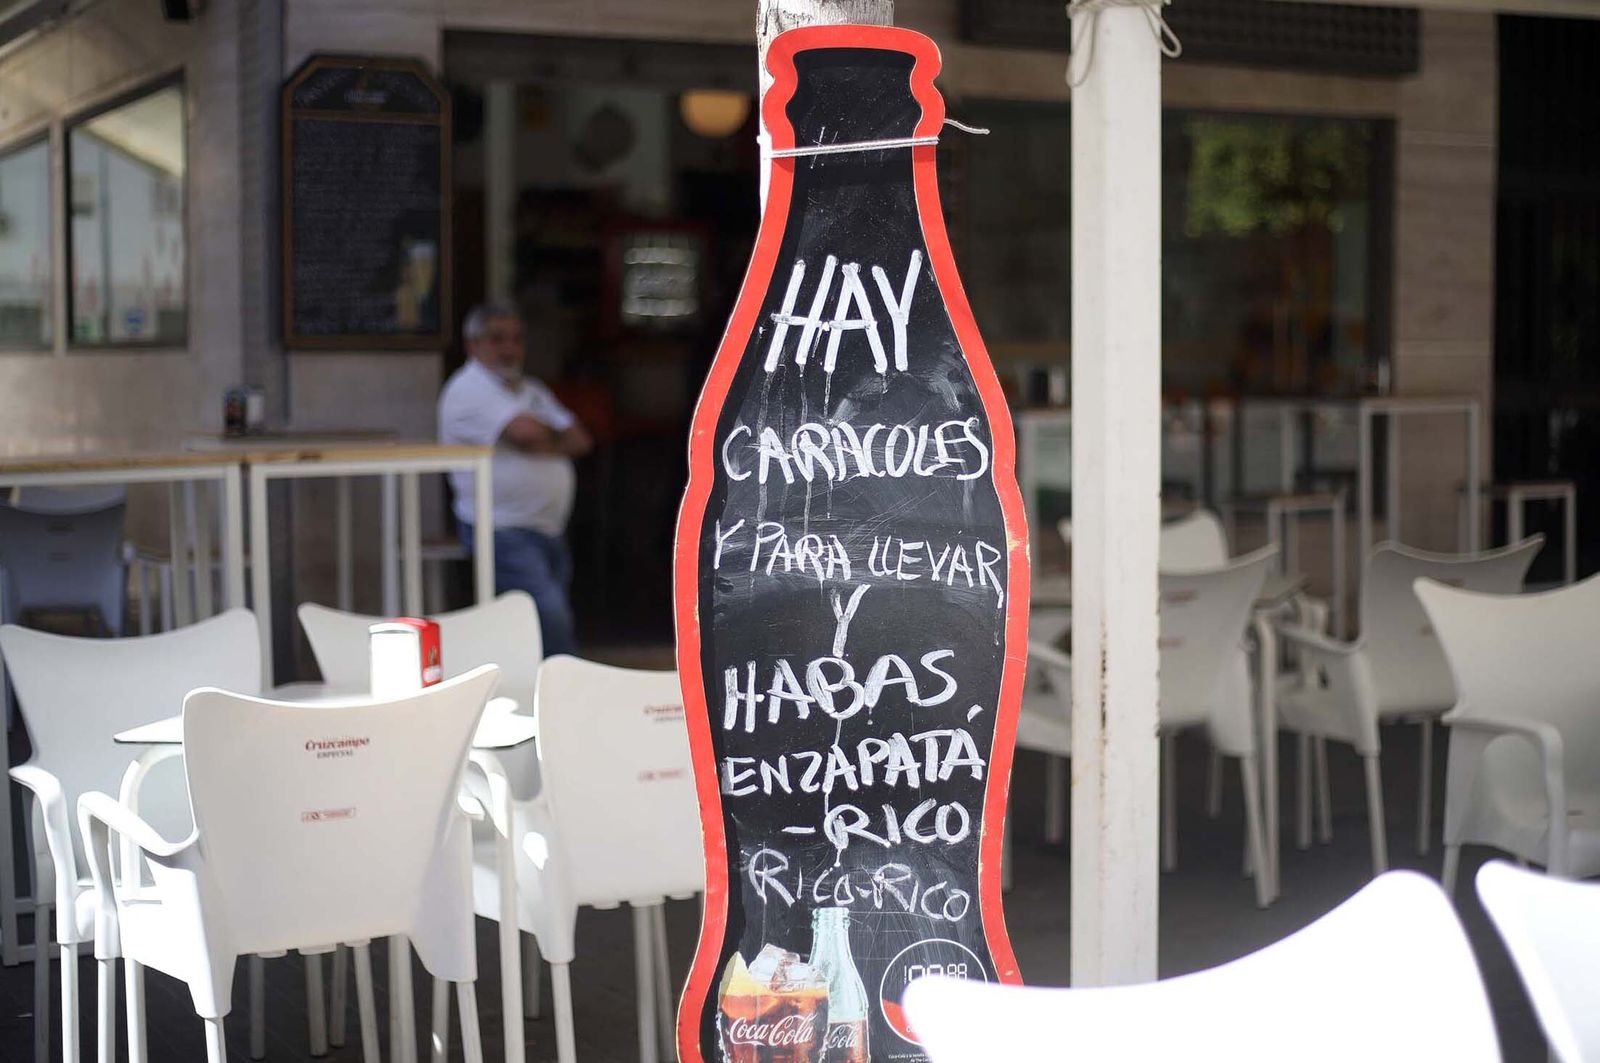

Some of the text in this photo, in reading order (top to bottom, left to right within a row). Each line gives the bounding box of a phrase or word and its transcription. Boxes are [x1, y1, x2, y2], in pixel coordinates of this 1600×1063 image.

[763, 250, 923, 373] HAY
[722, 417, 989, 484] CARACOLES
[713, 519, 1004, 606] Y PARA LLEVAR
[830, 583, 871, 657] Y
[723, 649, 957, 733] HABAS
[729, 1013, 817, 1046] Coca-Cola
